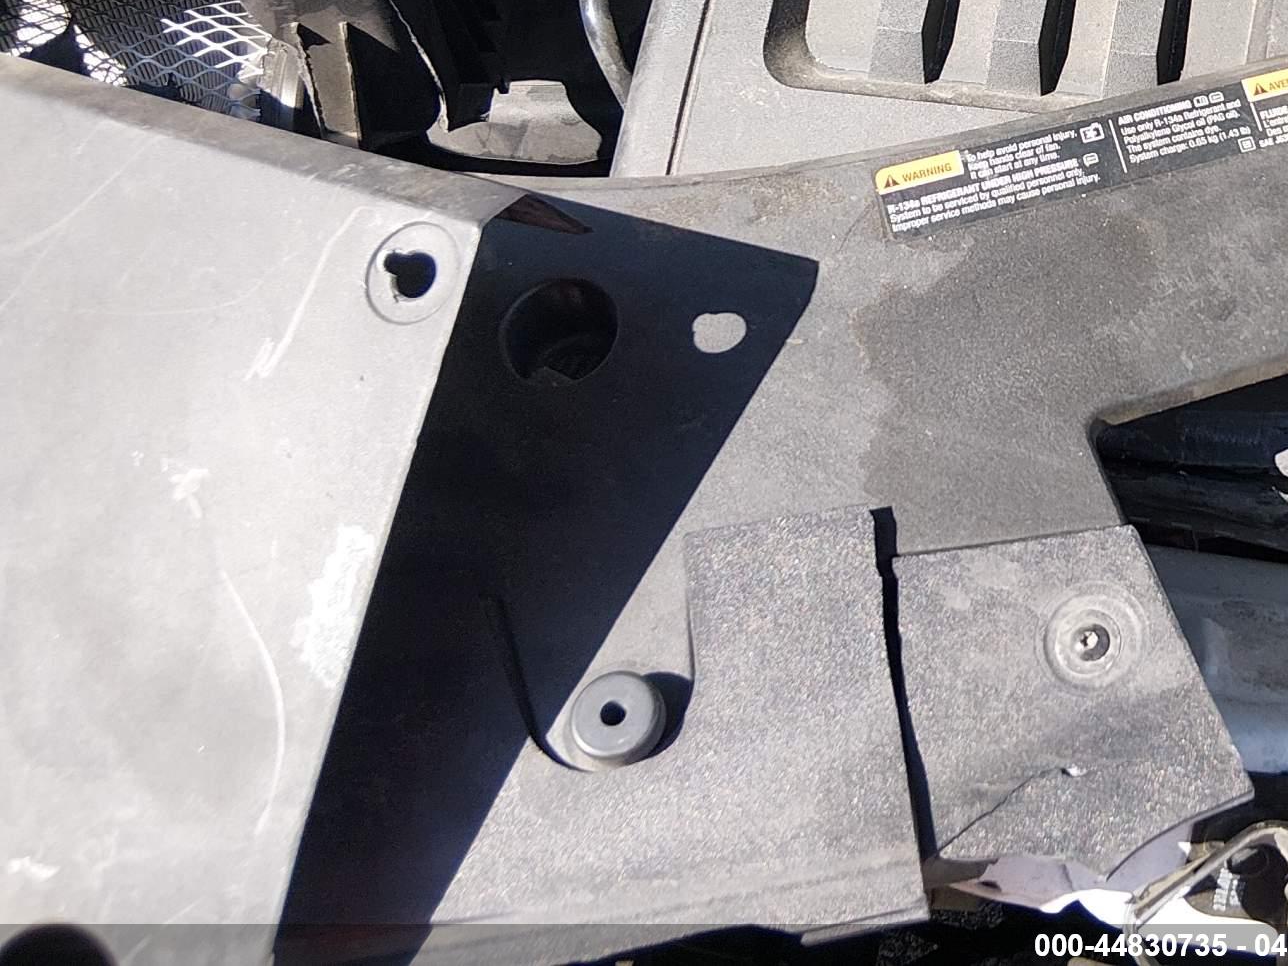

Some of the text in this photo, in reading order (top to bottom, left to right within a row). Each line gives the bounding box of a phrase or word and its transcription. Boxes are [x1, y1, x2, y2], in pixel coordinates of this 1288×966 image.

[1117, 99, 1193, 126] AIR CONDITIONING
[1120, 98, 1242, 136] Use only R-134a Refrigerant and
[1171, 119, 1196, 135] Glycol
[1195, 117, 1207, 128] oil
[1206, 112, 1226, 126] (PAG
[1225, 108, 1241, 121] oil).
[976, 148, 995, 161] help
[995, 142, 1018, 156] avoid
[1018, 134, 1053, 150] personal
[1052, 127, 1078, 143] injury,
[1126, 123, 1222, 155] The system contains dye.
[1129, 149, 1160, 165] System
[1159, 141, 1190, 157] charge:
[1188, 136, 1208, 149] 0.65
[1207, 133, 1220, 146] kg
[1218, 128, 1240, 142] (1.43
[1266, 126, 1283, 137] Des
[977, 168, 994, 178] can
[993, 163, 1014, 174] start
[1013, 161, 1023, 169] at
[1023, 158, 1039, 168] any
[1039, 151, 1061, 163] time.
[989, 153, 1015, 166] hands
[1014, 148, 1035, 160] clear
[1035, 145, 1045, 155] of
[1044, 141, 1061, 152] fan.
[902, 162, 952, 183] WARNING
[919, 182, 981, 206] REFRIGERANT
[980, 175, 1012, 191] UNDER
[1011, 168, 1034, 183] HIGH
[1033, 157, 1079, 177] PRESSURE
[889, 208, 922, 225] System
[921, 205, 932, 215] to
[931, 202, 944, 213] be
[943, 193, 980, 210] serviced
[979, 190, 991, 202] by
[990, 181, 1026, 199] qualified
[1025, 171, 1066, 190] personnel
[891, 172, 1101, 234] Improper service methods may cause personal injury.
